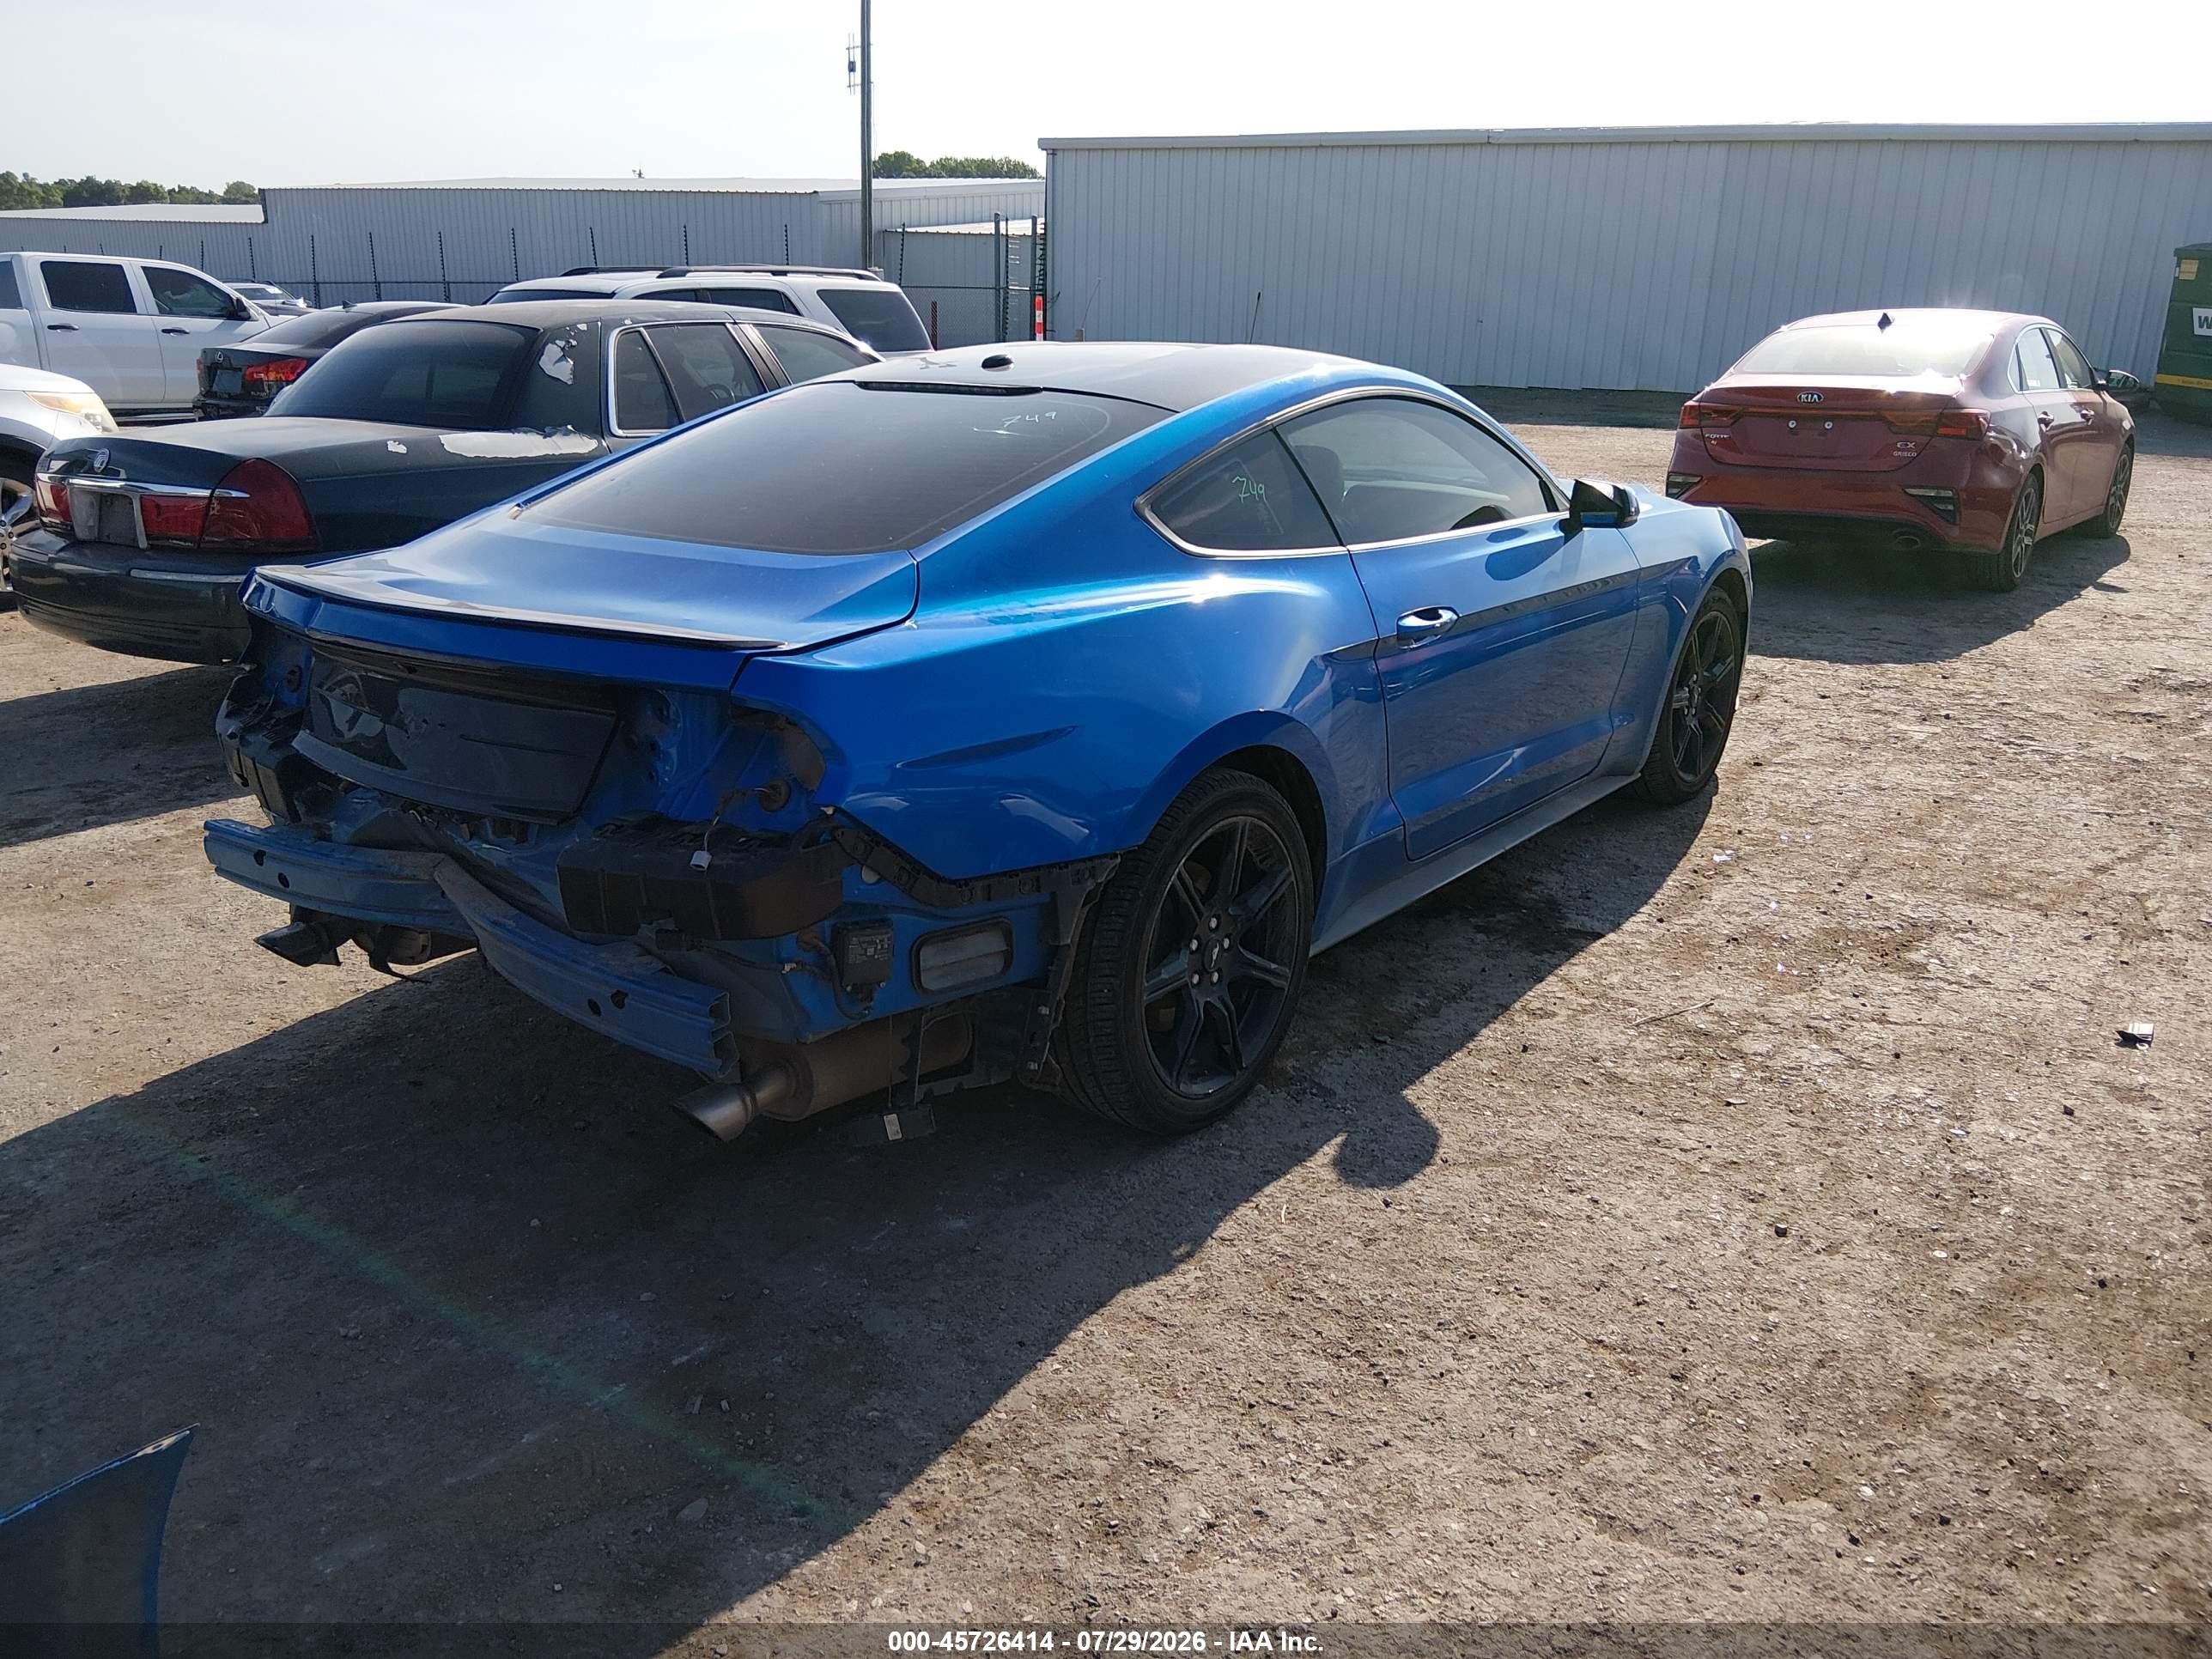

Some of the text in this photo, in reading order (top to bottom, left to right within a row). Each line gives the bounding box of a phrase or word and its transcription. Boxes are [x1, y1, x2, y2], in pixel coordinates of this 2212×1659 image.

[1801, 393, 1820, 403] KIA
[1001, 410, 1057, 428] 749
[1231, 476, 1267, 503] 749
